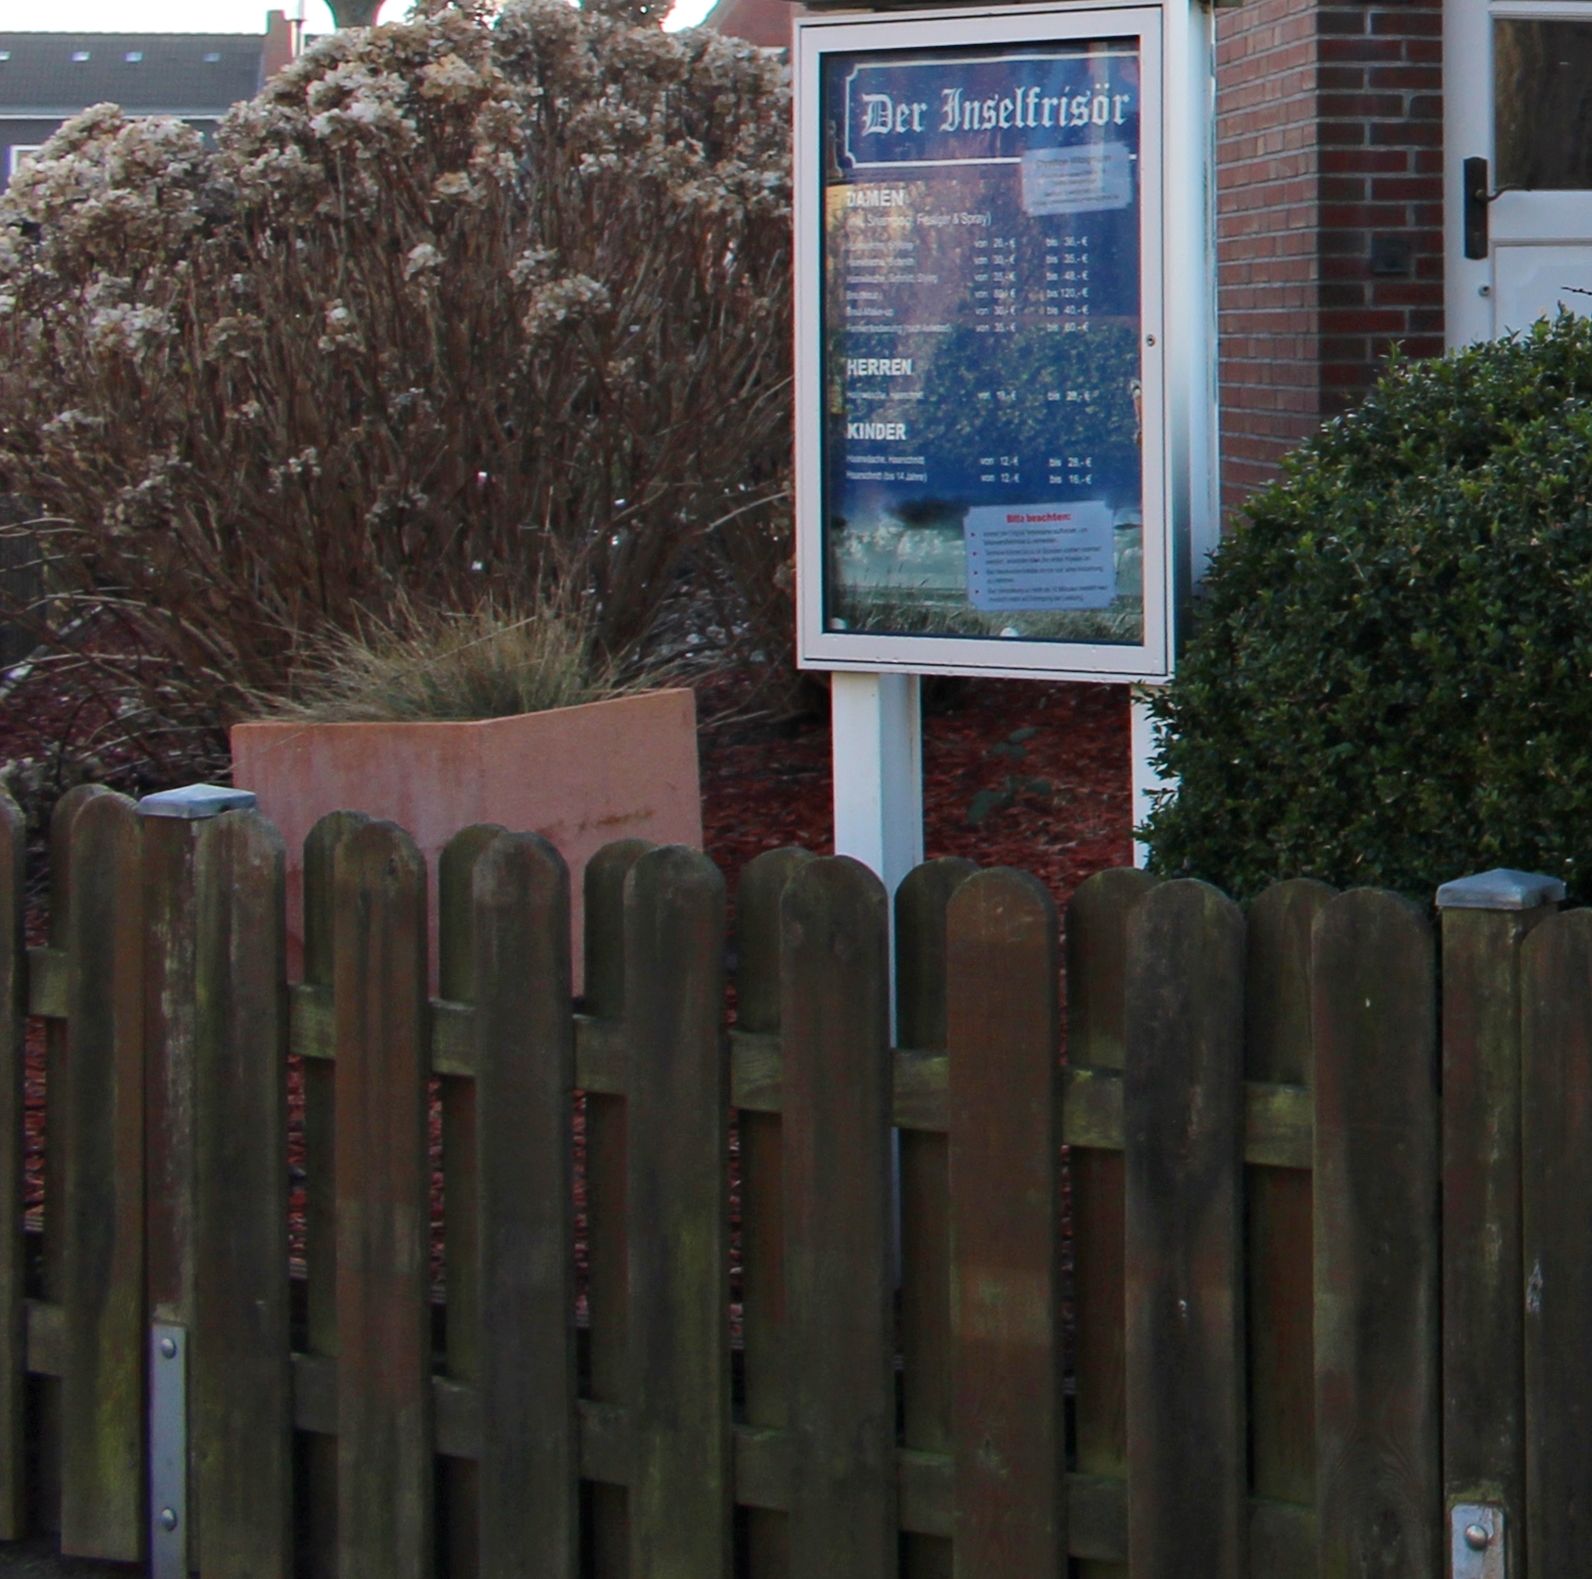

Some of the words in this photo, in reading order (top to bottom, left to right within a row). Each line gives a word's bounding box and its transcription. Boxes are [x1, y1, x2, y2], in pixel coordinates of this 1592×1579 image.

[861, 93, 928, 136] Der
[939, 83, 1130, 132] Inselfrisör
[846, 190, 905, 207] DAMEN
[960, 211, 991, 227] Spray)
[847, 358, 912, 376] HERREN
[847, 422, 907, 440] KINDER
[1006, 514, 1025, 523] Bitte
[1026, 513, 1072, 523] beachten:
